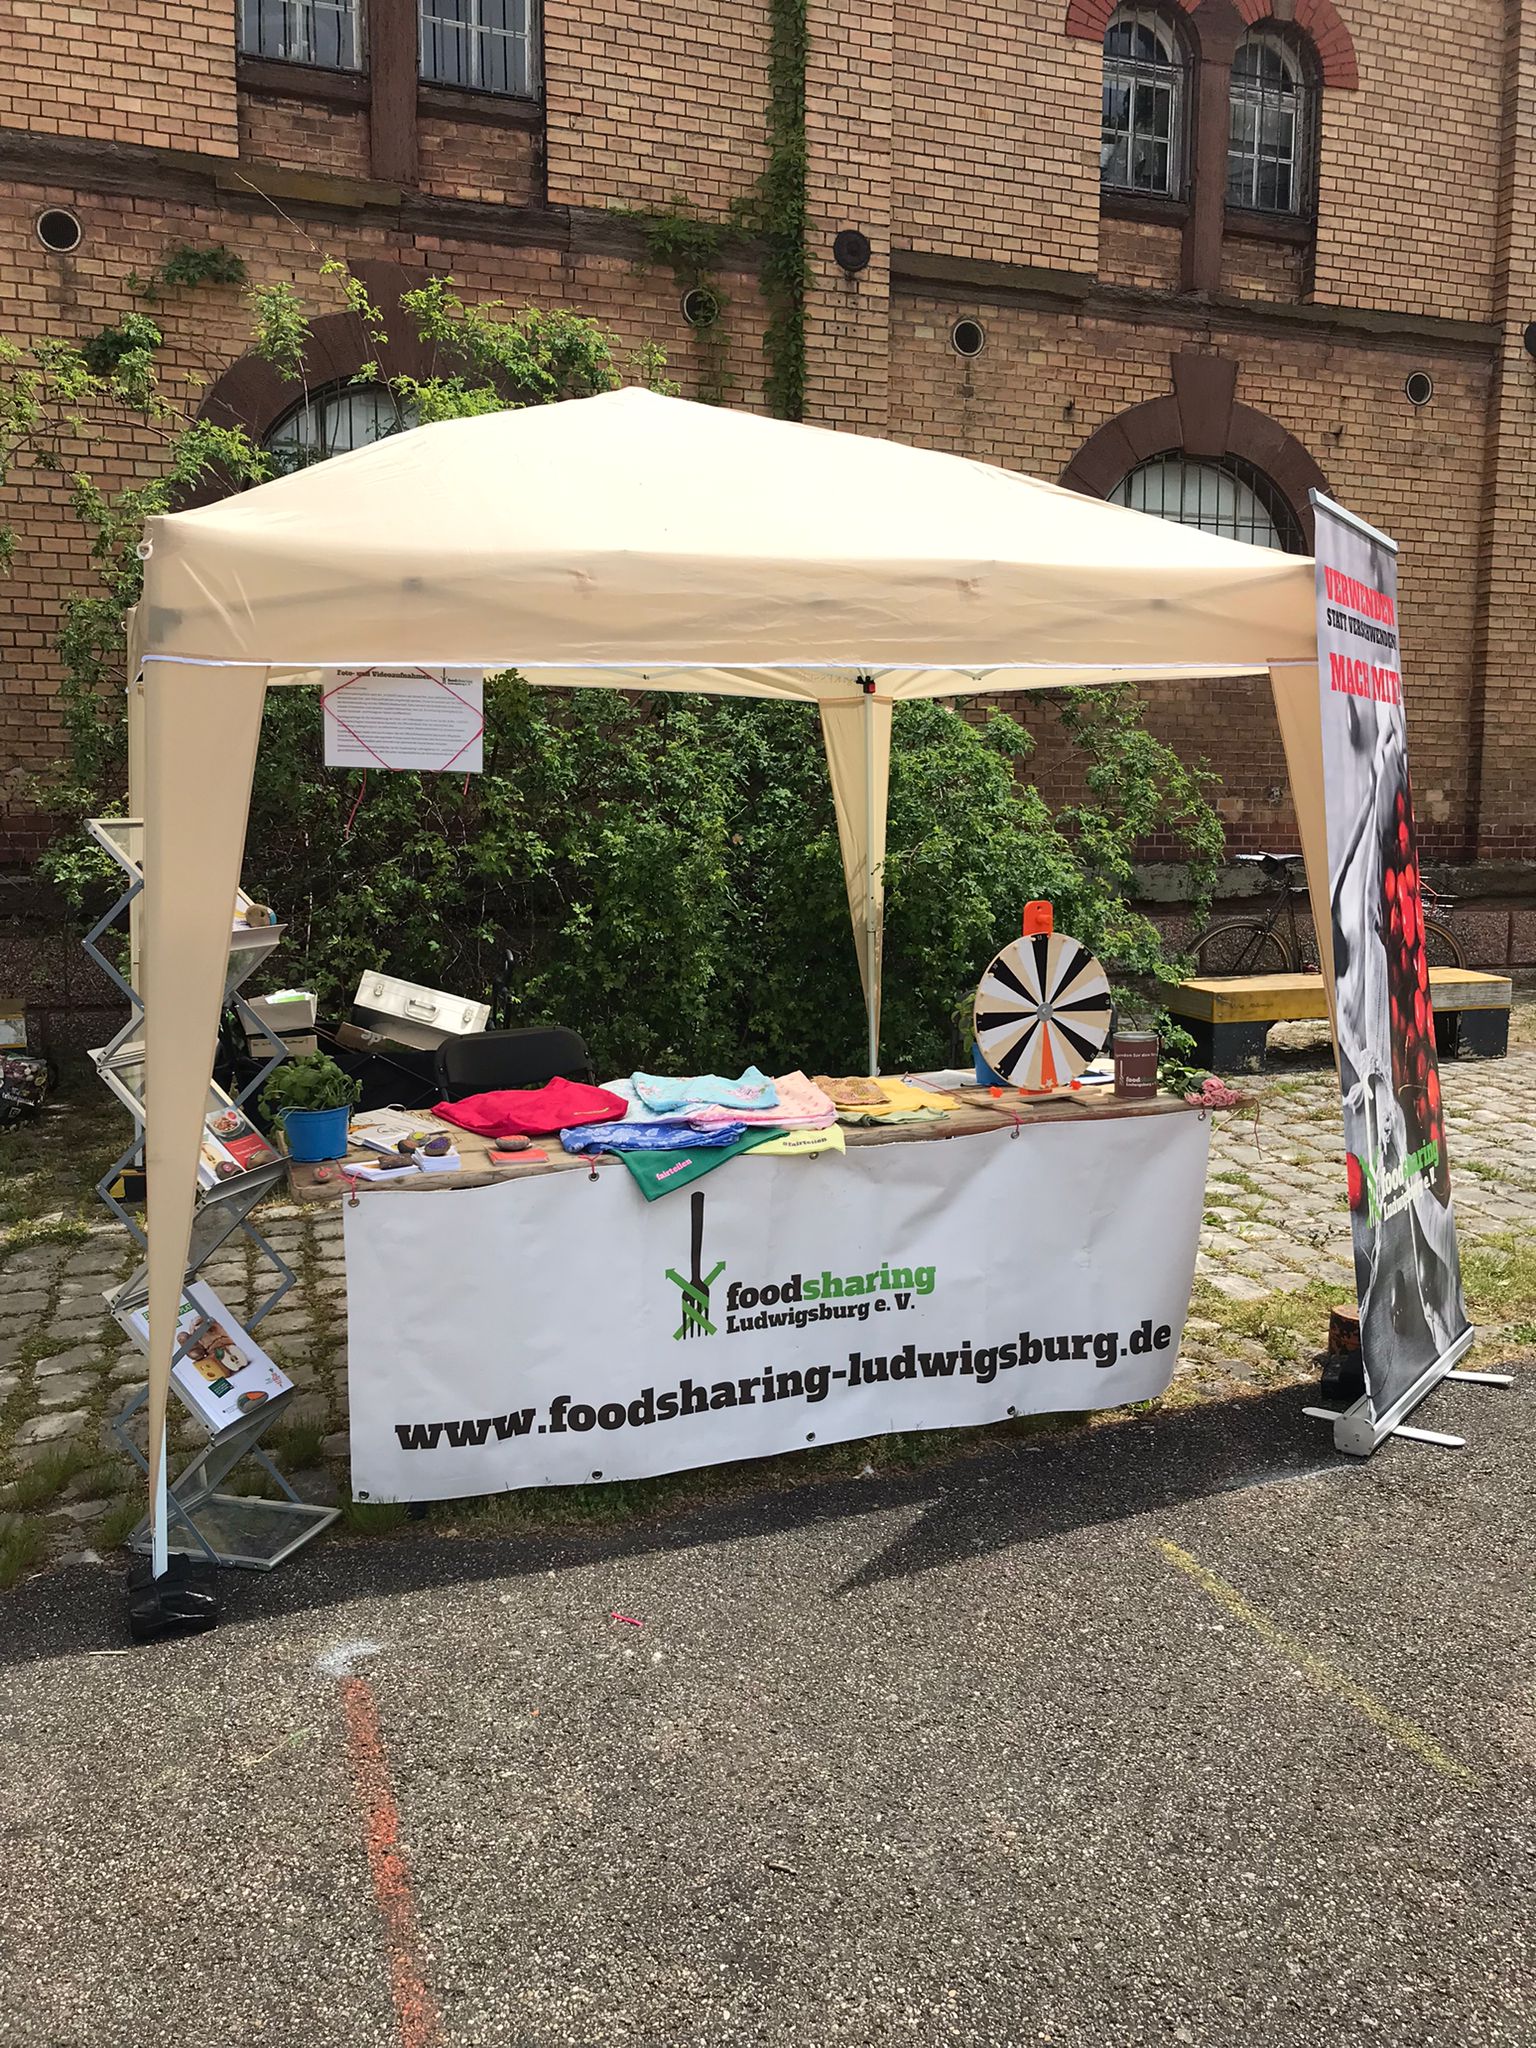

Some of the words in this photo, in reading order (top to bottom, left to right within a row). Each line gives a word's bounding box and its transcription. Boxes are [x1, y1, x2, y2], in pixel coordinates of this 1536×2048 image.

[1324, 565, 1395, 626] VERWENDEN
[1326, 607, 1347, 632] STATT
[1329, 651, 1371, 699] MACH
[1371, 664, 1402, 706] MIT!
[656, 1158, 693, 1181] fairteilen
[726, 1262, 937, 1312] foodsharing
[726, 1302, 870, 1334] Ludwigsburg
[874, 1299, 891, 1312] e.
[894, 1292, 916, 1310] V.
[394, 1319, 1173, 1451] www.foodsharing-ludwigsburg.de
